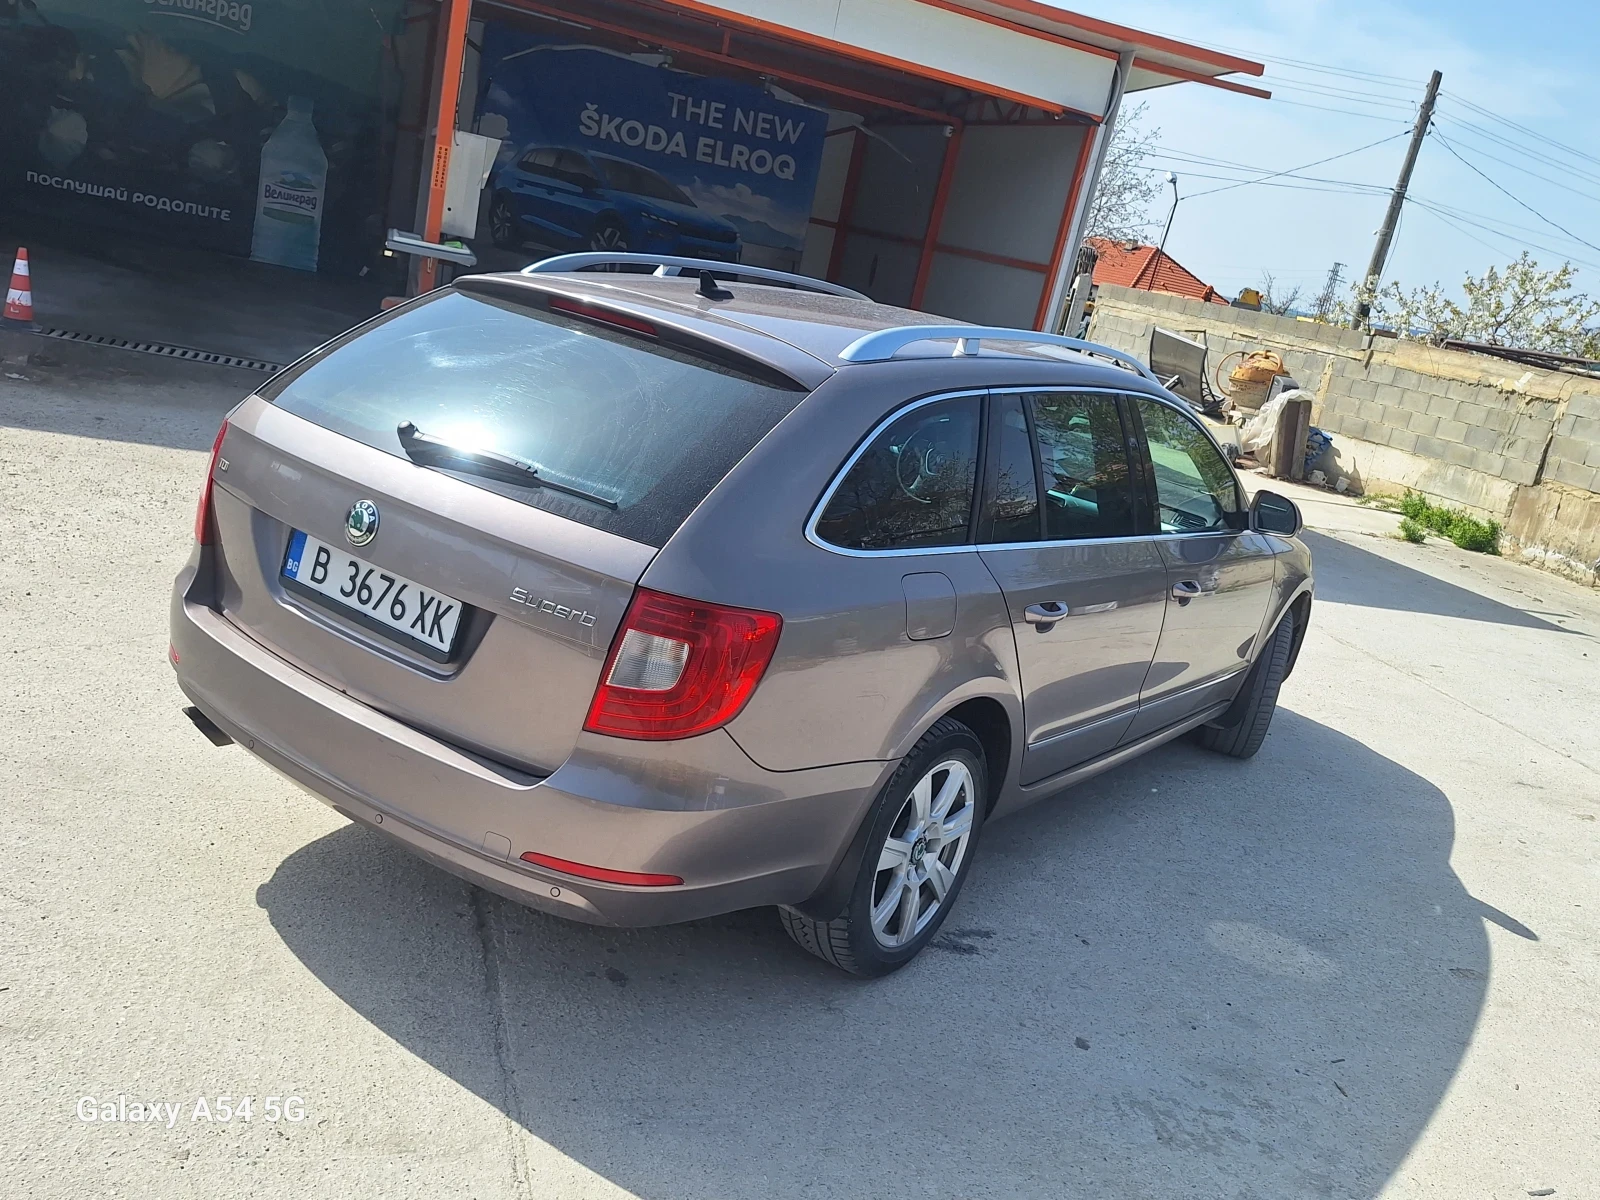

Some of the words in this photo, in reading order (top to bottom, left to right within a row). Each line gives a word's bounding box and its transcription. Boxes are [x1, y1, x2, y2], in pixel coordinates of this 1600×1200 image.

[579, 101, 688, 158] ŠKODA
[696, 136, 797, 181] ELROQ
[667, 91, 727, 130] THE
[732, 106, 805, 145] NEW
[26, 170, 128, 201] ПОСЛУШАЙ
[132, 192, 231, 221] РОДОПИТЕ
[264, 184, 318, 210] Велинград
[287, 558, 299, 573] BG
[310, 545, 331, 585] B
[340, 560, 408, 621] 3676
[410, 590, 453, 644] XK
[509, 586, 598, 627] Superb
